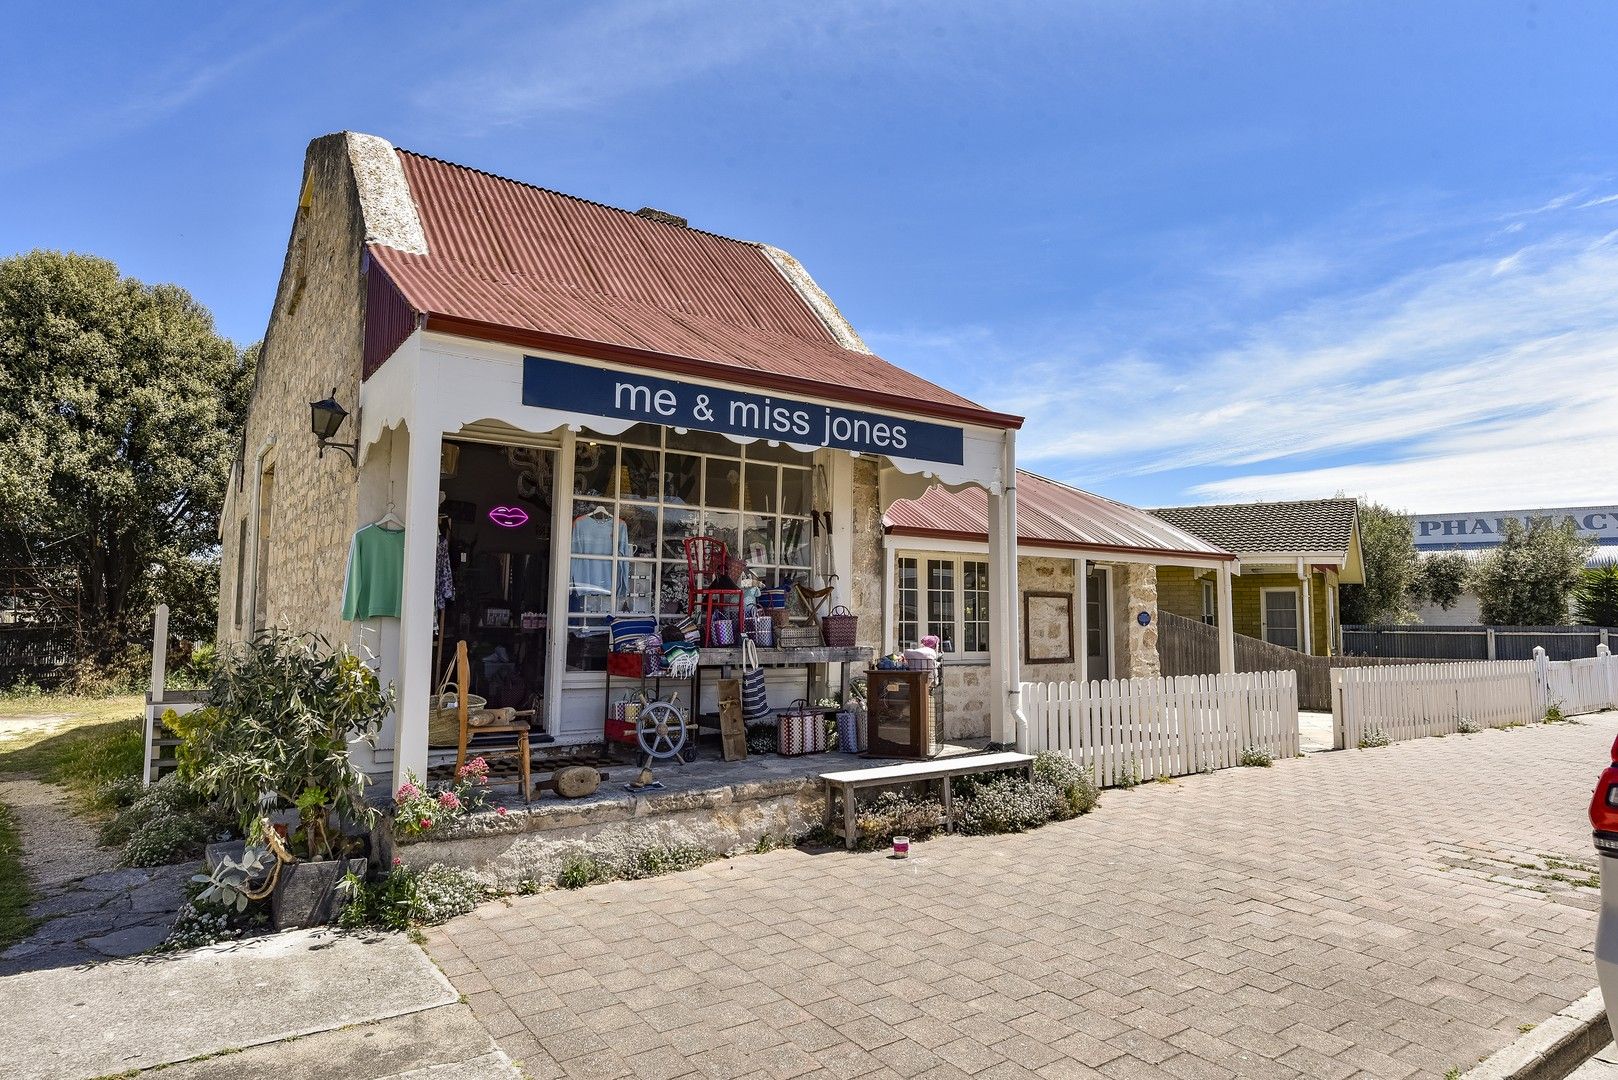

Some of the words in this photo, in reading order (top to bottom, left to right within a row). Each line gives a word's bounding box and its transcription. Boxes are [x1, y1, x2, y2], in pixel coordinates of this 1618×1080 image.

[616, 382, 677, 416] me
[693, 394, 715, 422] &
[729, 398, 810, 435] miss
[821, 407, 907, 449] jones
